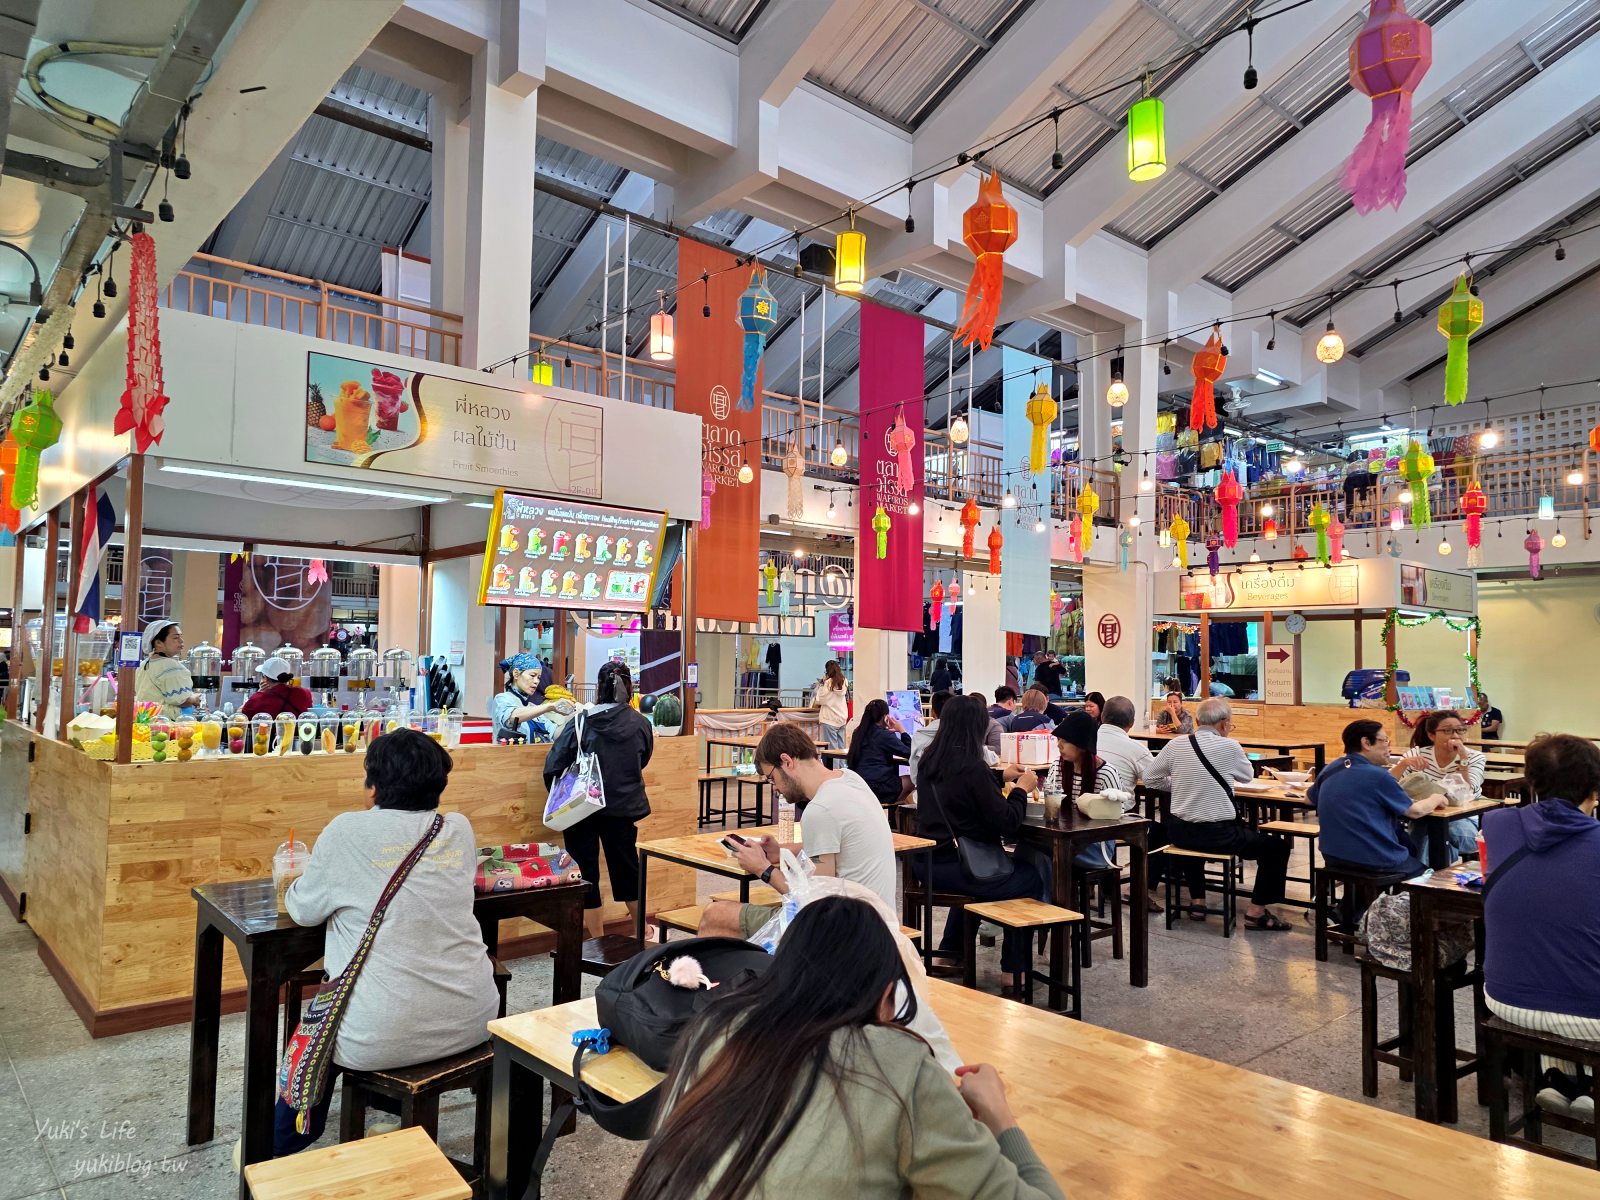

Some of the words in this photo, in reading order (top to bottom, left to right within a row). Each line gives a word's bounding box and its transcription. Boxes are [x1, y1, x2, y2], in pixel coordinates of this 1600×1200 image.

[455, 394, 511, 421] พี่หลวง
[453, 425, 516, 451] ผลไม้ปั่น
[452, 459, 472, 471] Fruit
[475, 463, 519, 477] Smoothies
[1241, 572, 1295, 590] เครื่องดื่ม
[1247, 592, 1289, 601] Beverages
[1267, 678, 1291, 686] Return
